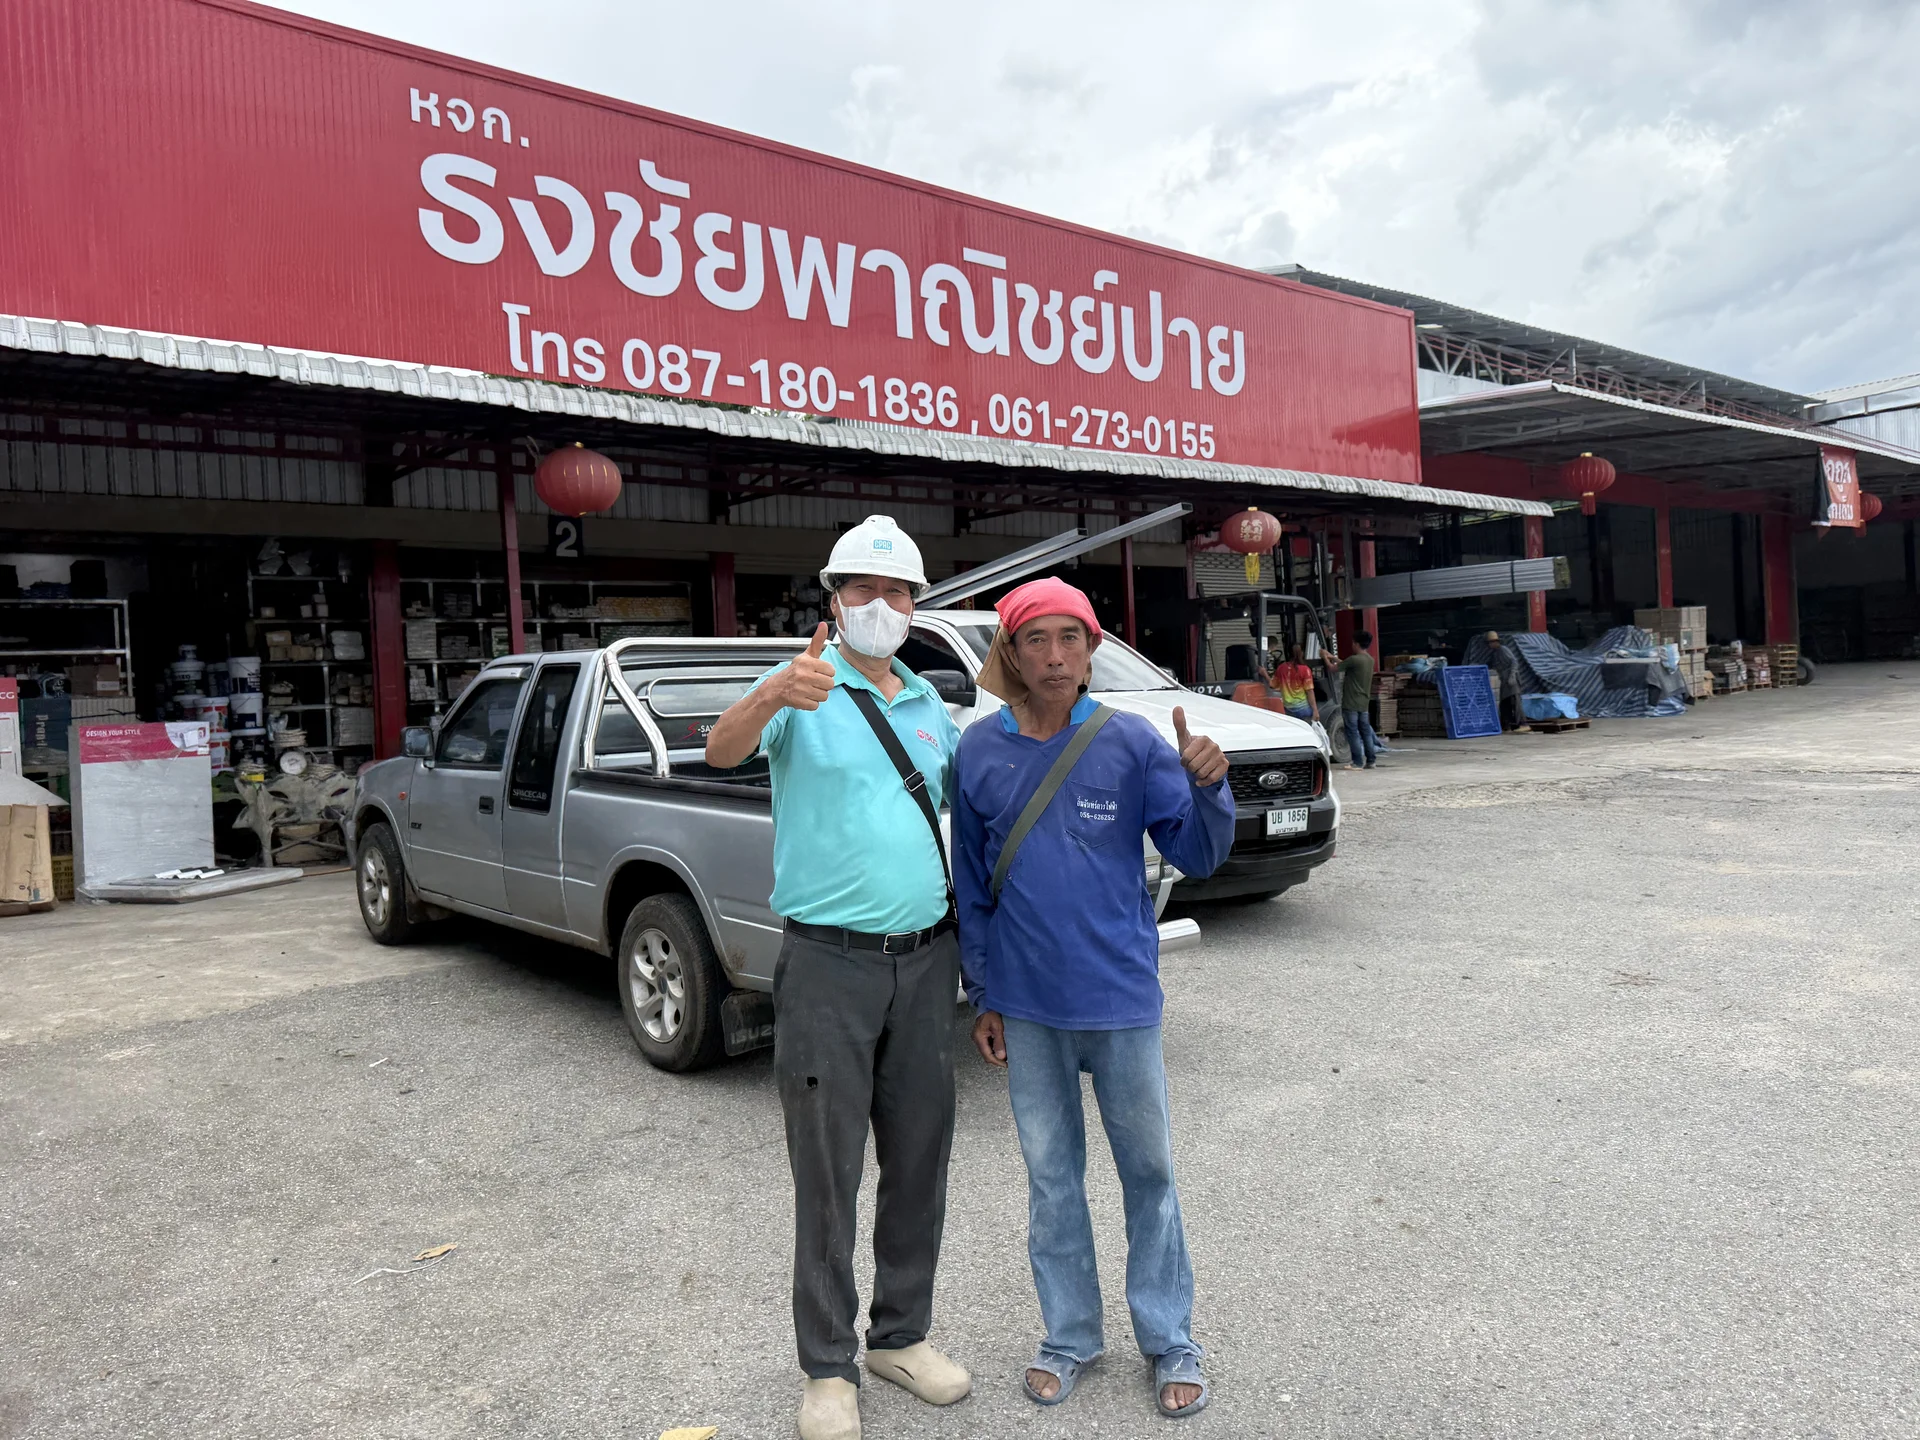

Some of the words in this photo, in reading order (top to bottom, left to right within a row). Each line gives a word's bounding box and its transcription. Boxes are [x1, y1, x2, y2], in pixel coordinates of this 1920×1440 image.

[409, 87, 530, 149] หจก.
[418, 152, 1247, 397] ธงชัยพาณิชย์ปาย
[502, 302, 607, 383] โทร
[621, 338, 960, 429] 087-180-1836
[988, 392, 1217, 460] 061-273-0155
[555, 520, 579, 558] 2
[874, 540, 892, 550] CPAC
[1188, 685, 1223, 694] YOTA
[1267, 774, 1284, 785] Ford
[512, 788, 548, 800] SPACECAB
[1287, 809, 1307, 823] 1856
